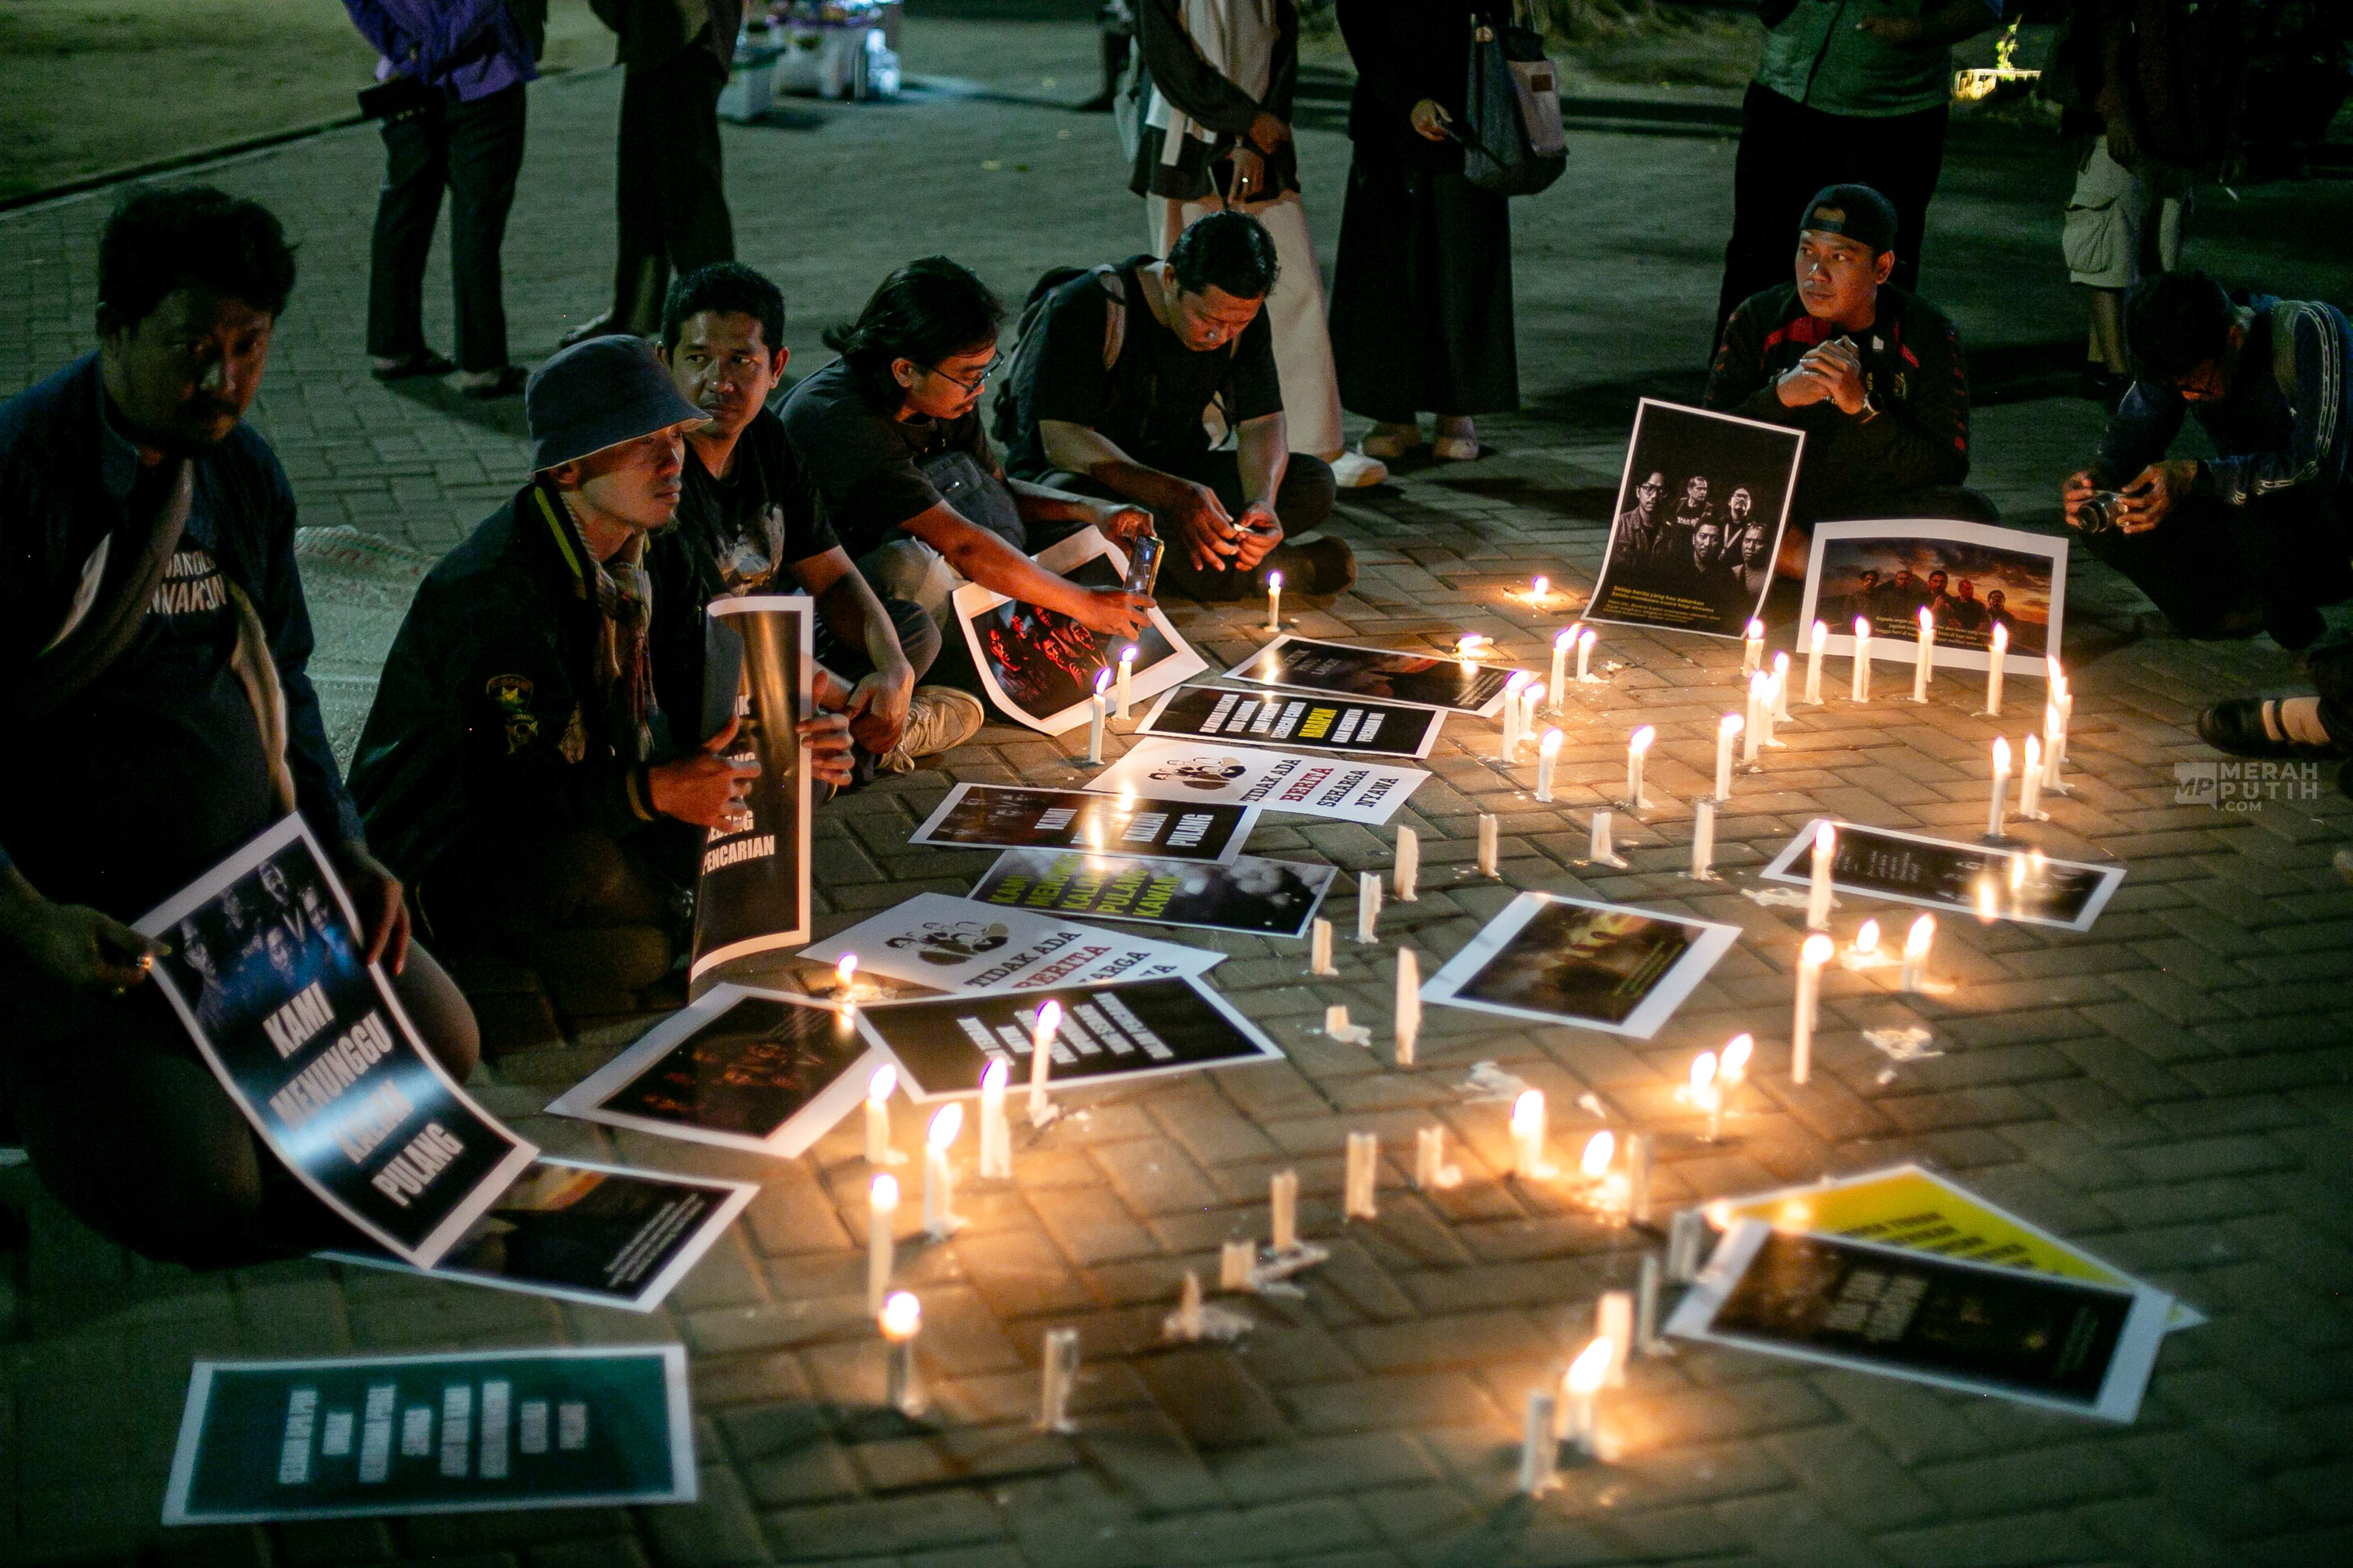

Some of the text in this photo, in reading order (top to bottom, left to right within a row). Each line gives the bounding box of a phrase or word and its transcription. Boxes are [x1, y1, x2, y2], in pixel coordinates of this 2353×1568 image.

[1297, 707, 1338, 737] HARAPAN
[1239, 759, 1302, 802] TIDAK ADA
[1279, 768, 1335, 802] BERITA
[1316, 770, 1371, 807] SEHARGA
[1354, 778, 1399, 807] NYAWA
[1033, 808, 1078, 830] KAMI
[1166, 814, 1214, 847] PULANG
[1096, 868, 1150, 914] PULANG
[1132, 873, 1182, 917] KAWAN
[963, 932, 1083, 988] TIDAK ADA
[262, 980, 337, 1060] KAMI
[268, 1010, 394, 1132] MENUNGGU
[370, 1122, 465, 1208] PULANG
